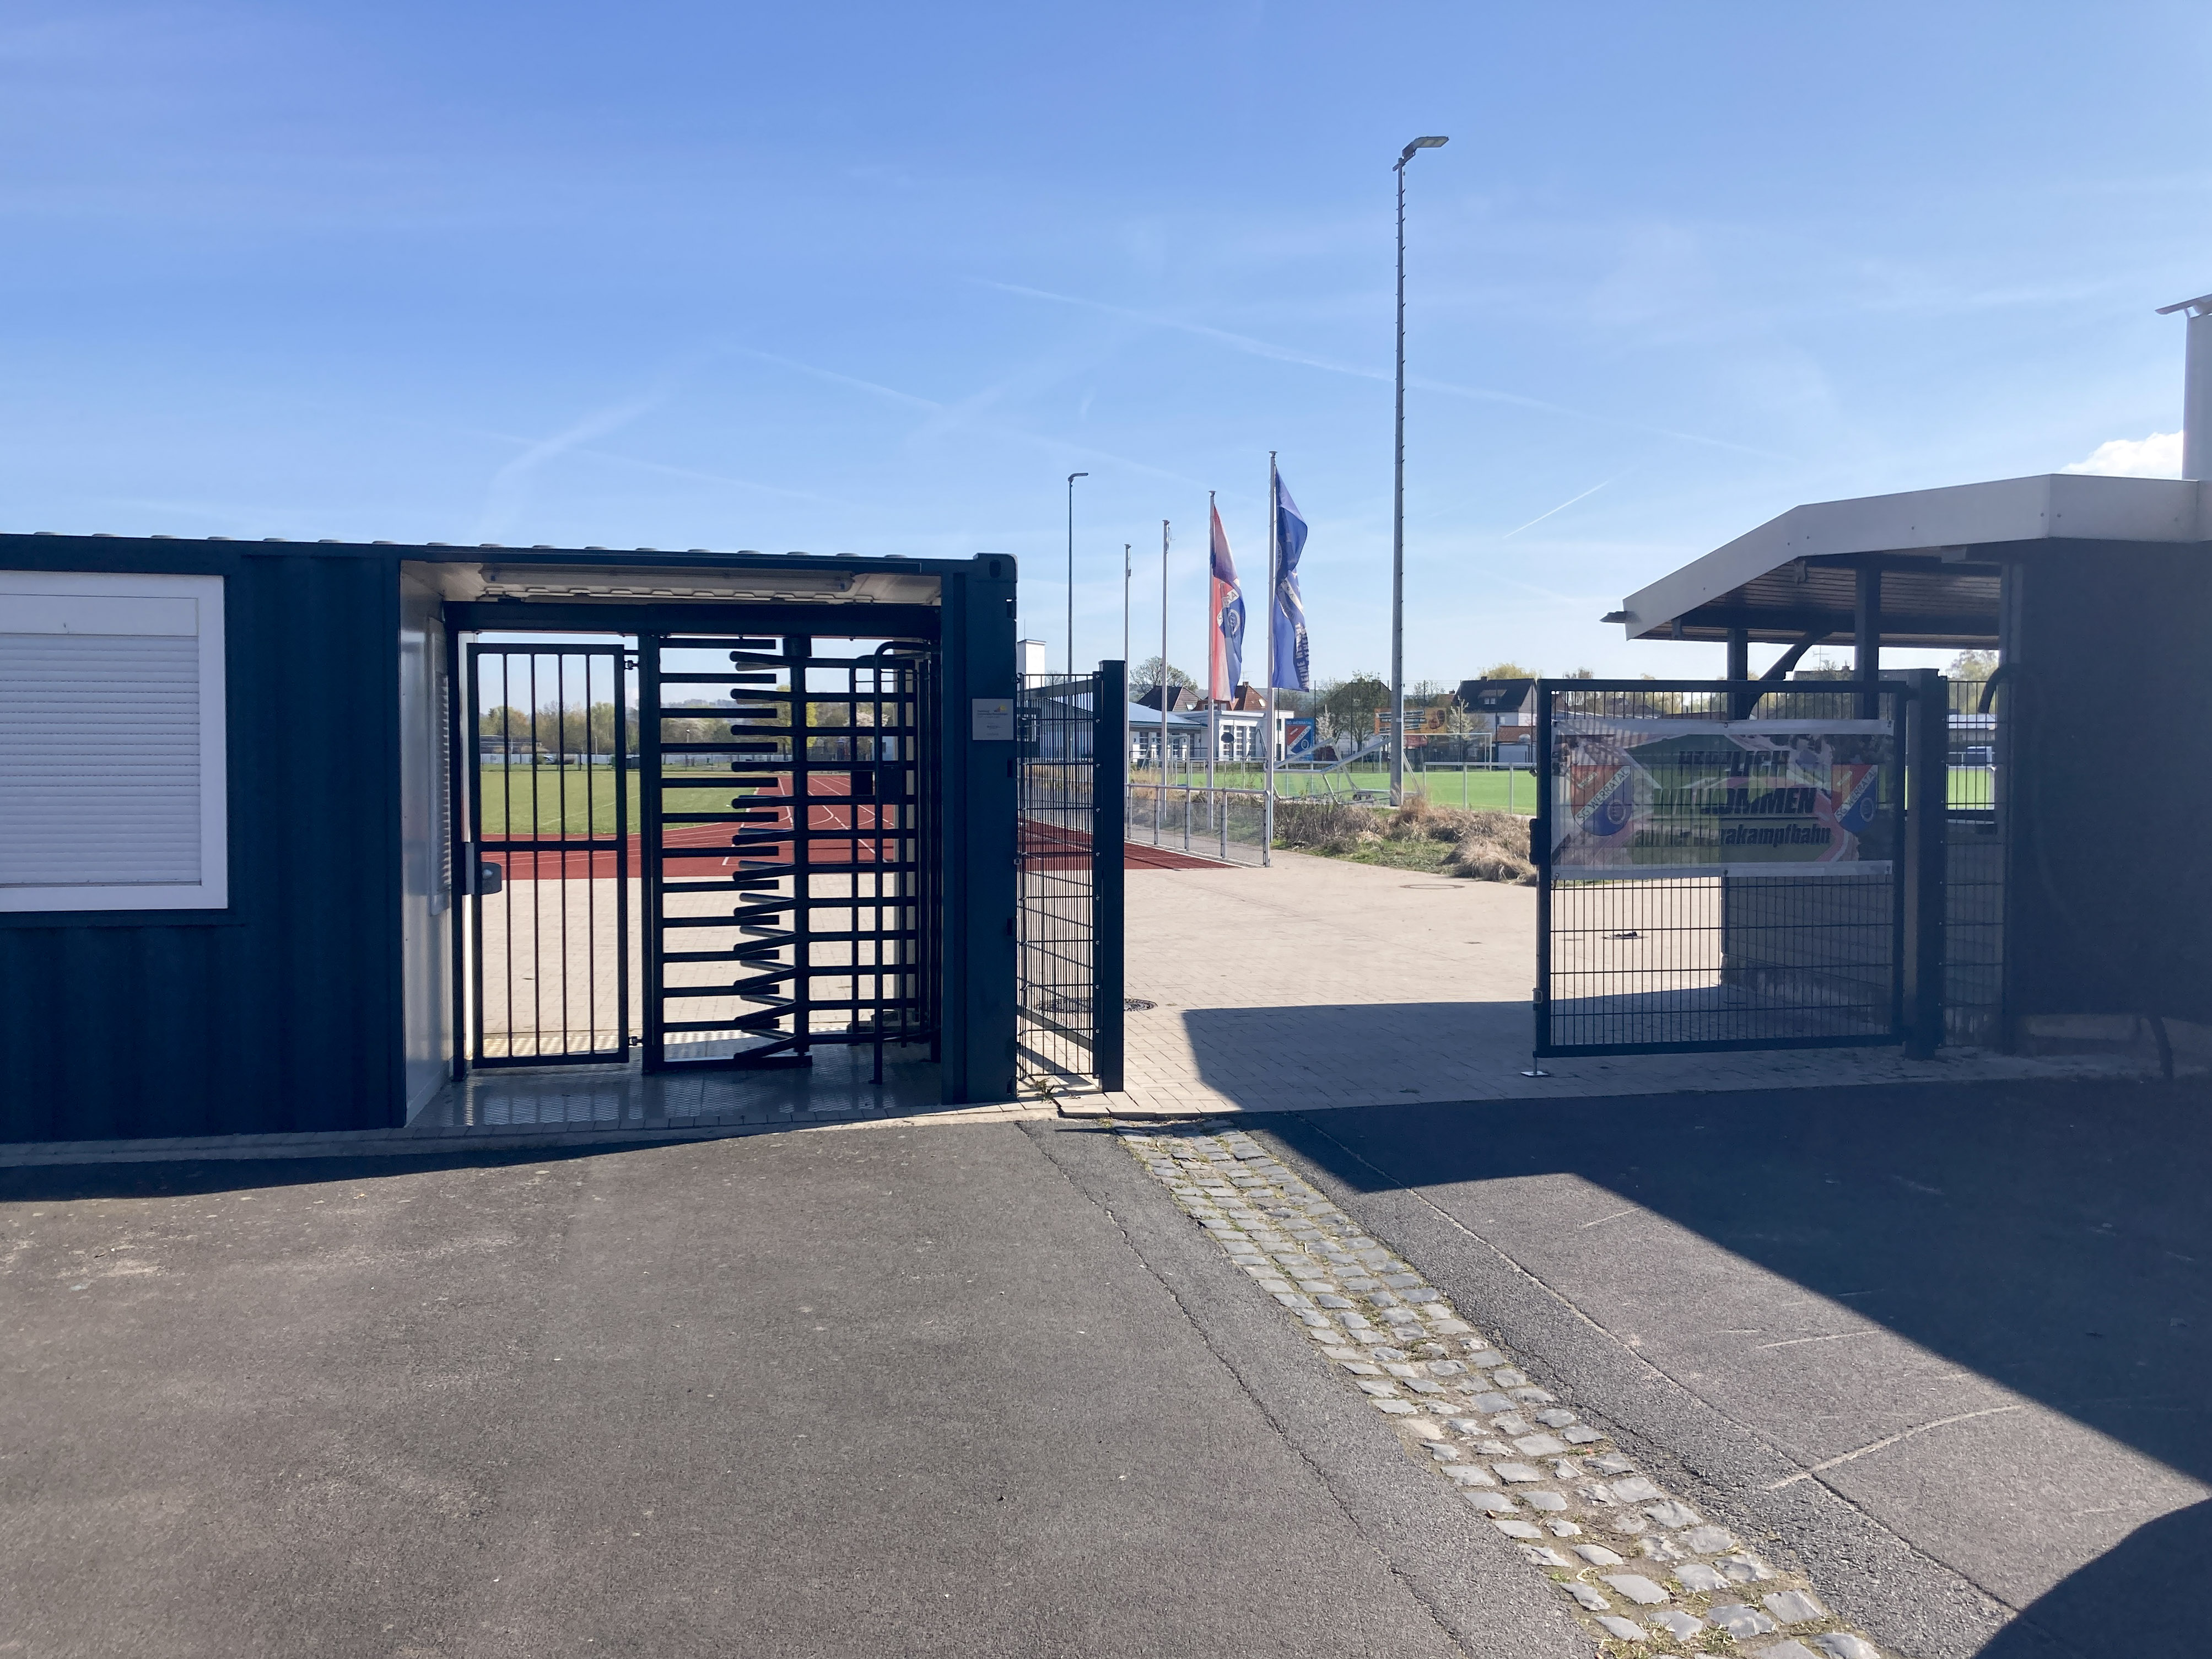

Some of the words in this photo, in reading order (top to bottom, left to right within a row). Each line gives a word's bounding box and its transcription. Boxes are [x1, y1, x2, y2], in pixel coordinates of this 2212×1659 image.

[1577, 807, 1590, 822] SG
[1588, 769, 1629, 810] WERRATAL
[1652, 788, 1817, 814] WILLKOMMEN
[1836, 808, 1847, 820] SG
[1845, 769, 1877, 806] WERRATAL
